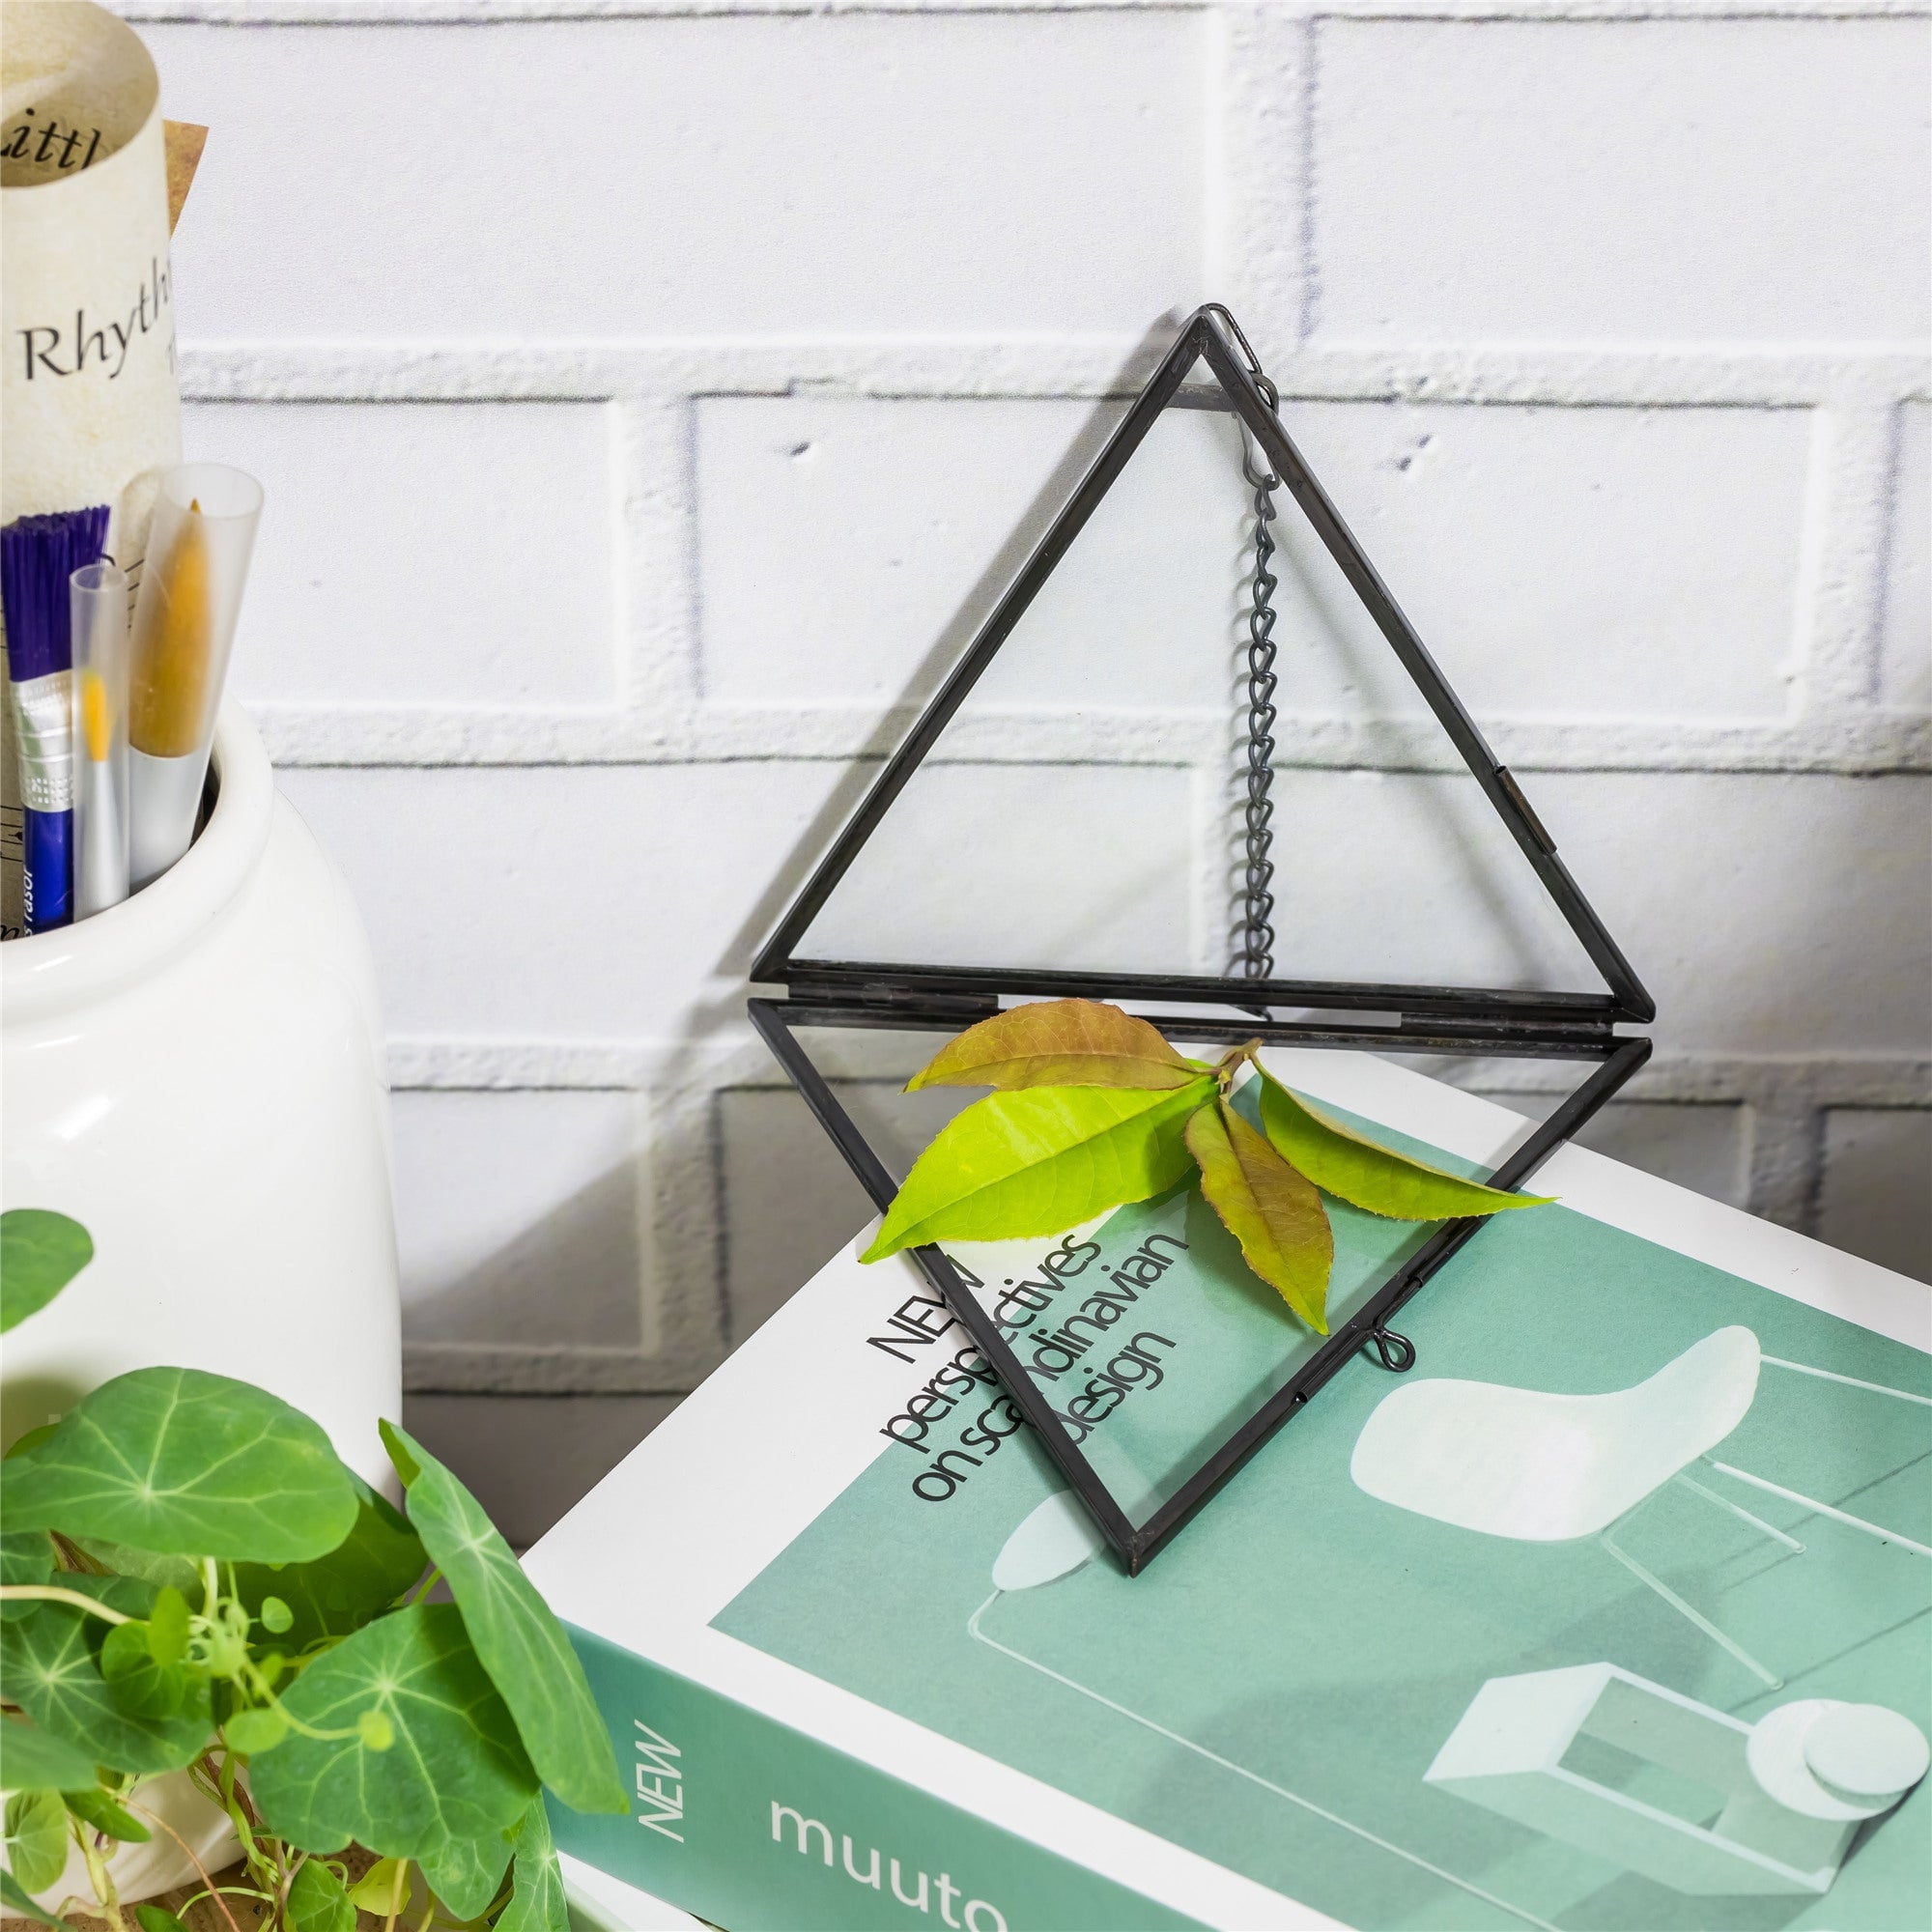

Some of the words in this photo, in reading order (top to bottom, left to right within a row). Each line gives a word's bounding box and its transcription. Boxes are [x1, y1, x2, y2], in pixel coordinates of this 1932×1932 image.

[0, 108, 101, 170] ittl
[16, 257, 172, 381] Rhyth
[912, 1450, 983, 1502] on
[634, 1719, 684, 1843] NEW
[771, 1801, 1008, 1932] muuto
